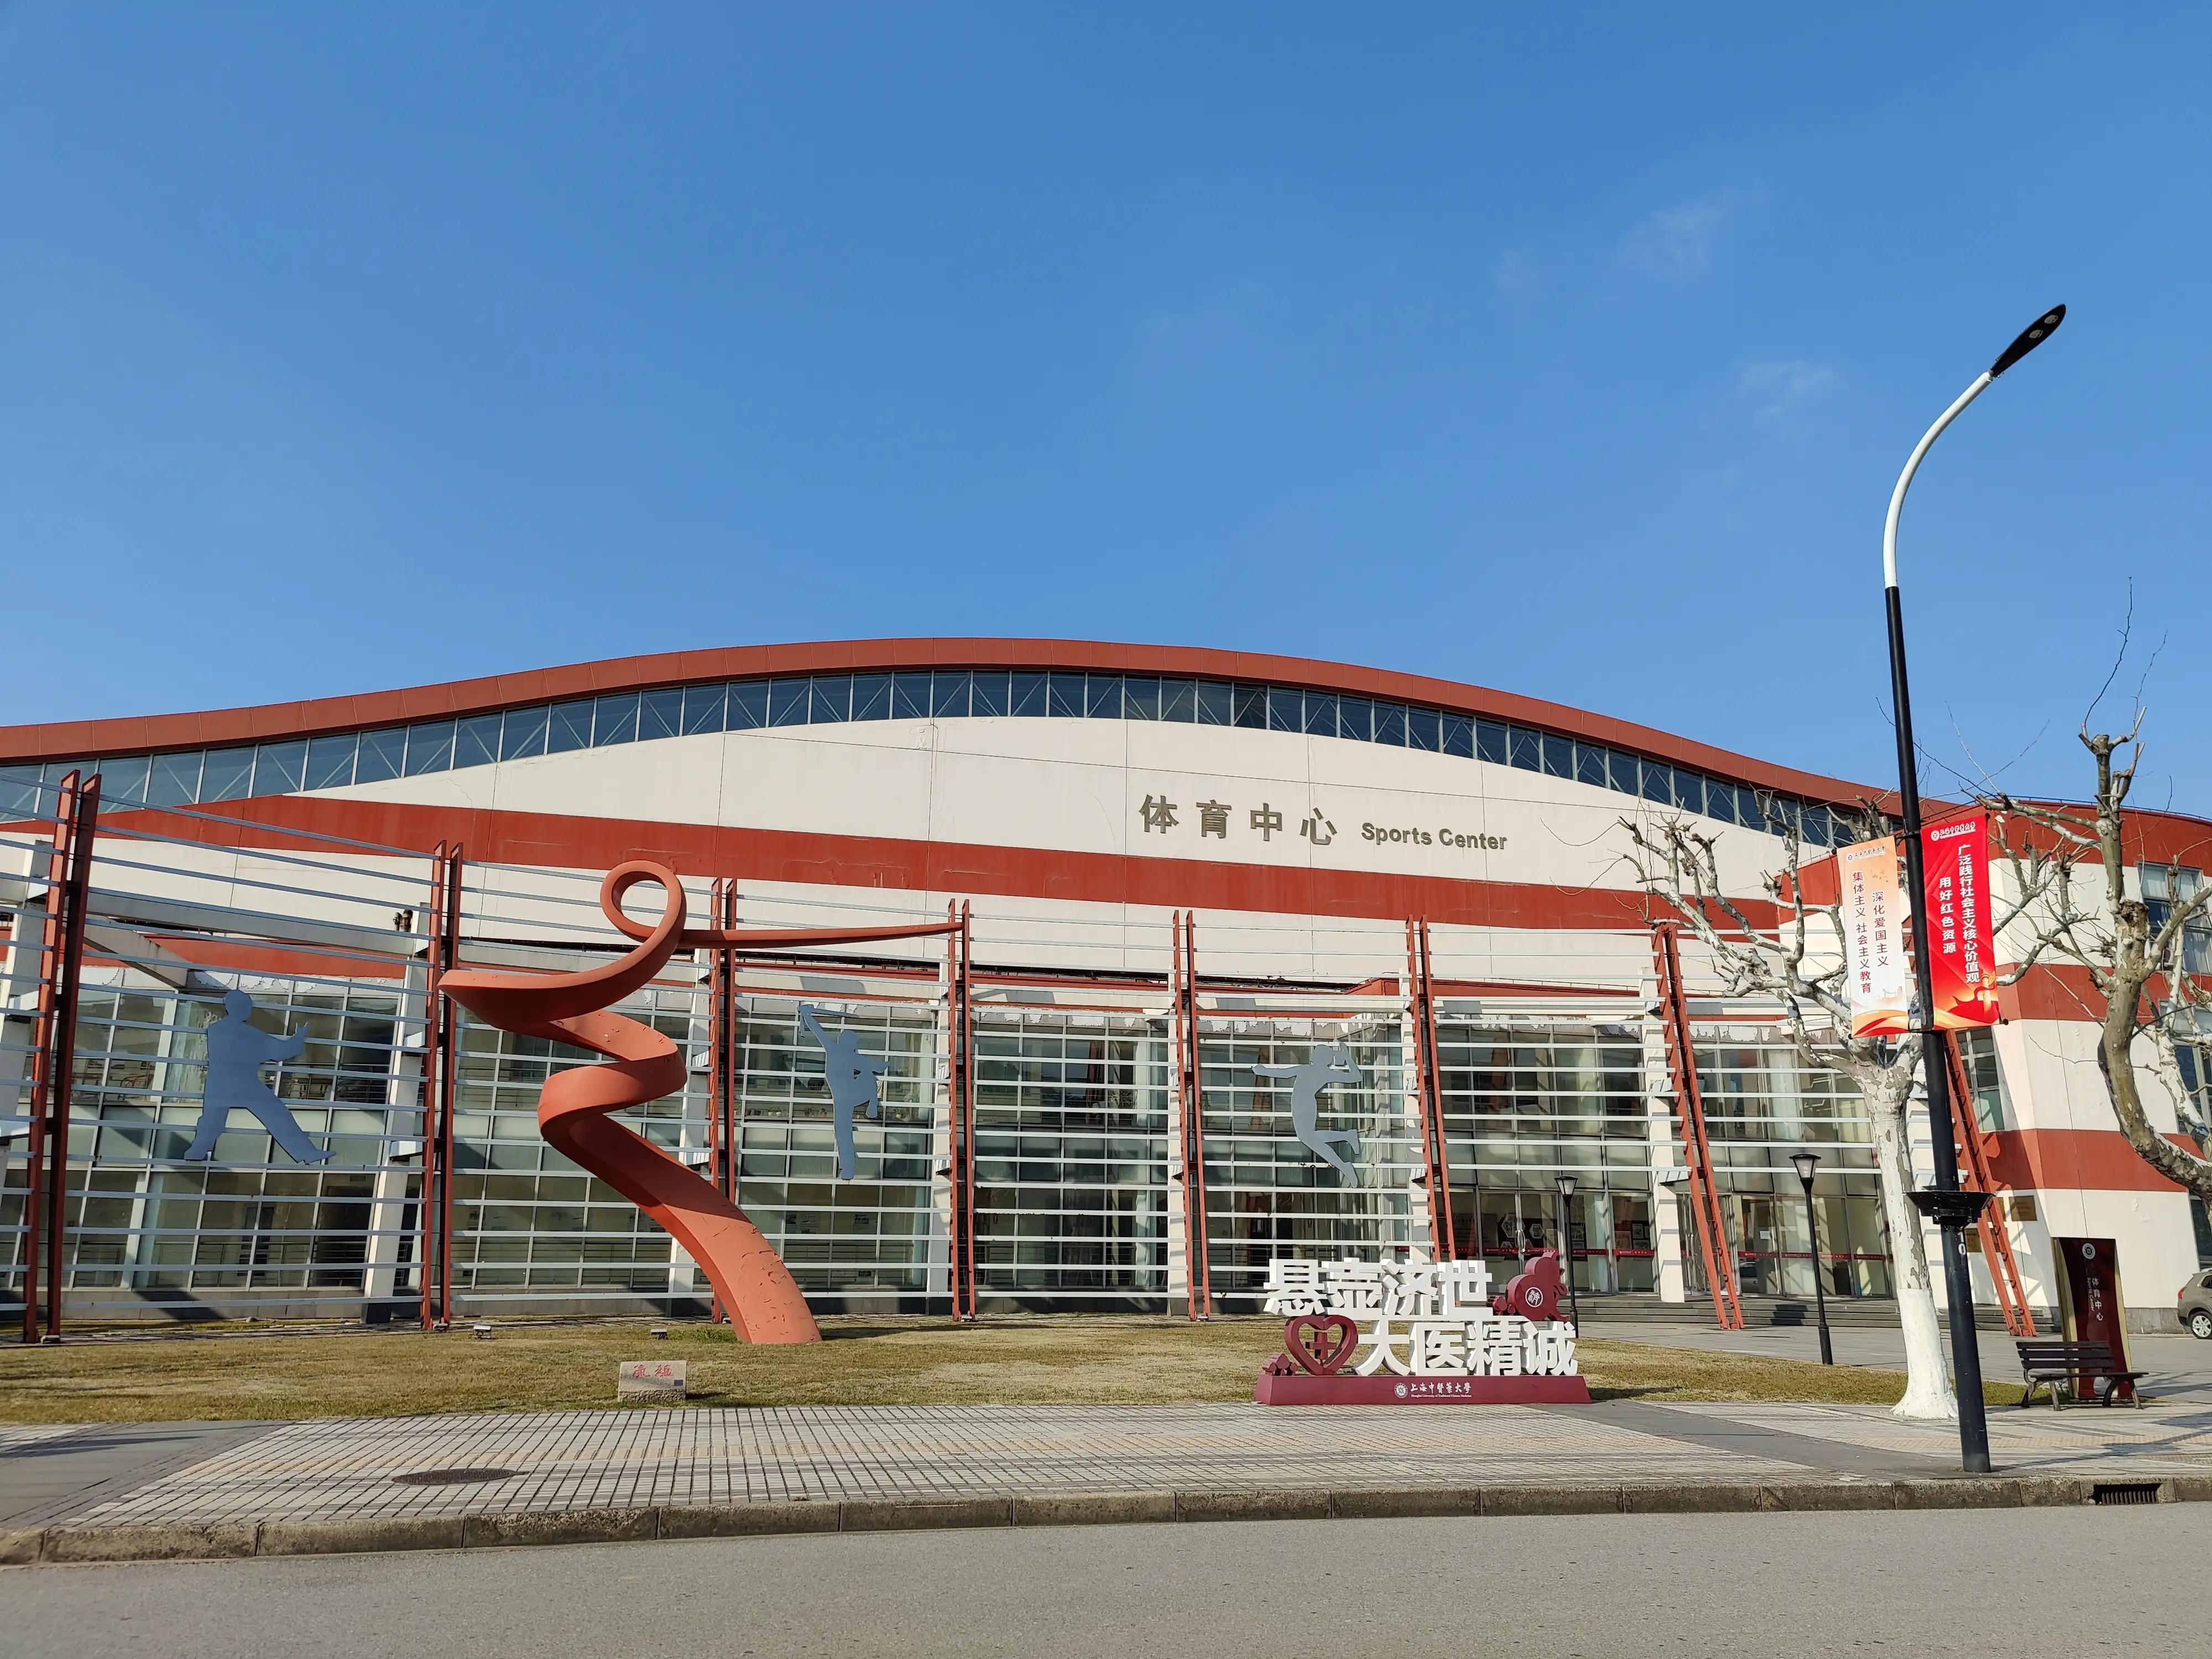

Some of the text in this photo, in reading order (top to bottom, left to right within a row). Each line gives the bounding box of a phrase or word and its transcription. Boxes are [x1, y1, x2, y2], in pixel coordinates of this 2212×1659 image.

[1139, 795, 1337, 846] 体育中心
[1361, 822, 1507, 850] Sports Center
[1853, 872, 1871, 994] 集体主义 社会主义教育
[1872, 891, 1888, 967] 深化爱国主义
[1939, 876, 1956, 954] 用好红色资源
[1958, 844, 1980, 983] 广泛践行社会主义核心价值观
[1263, 1257, 1493, 1321] 悬壶济世
[2092, 1277, 2104, 1321] 体育中心
[1354, 1318, 1578, 1376] 大医精诚
